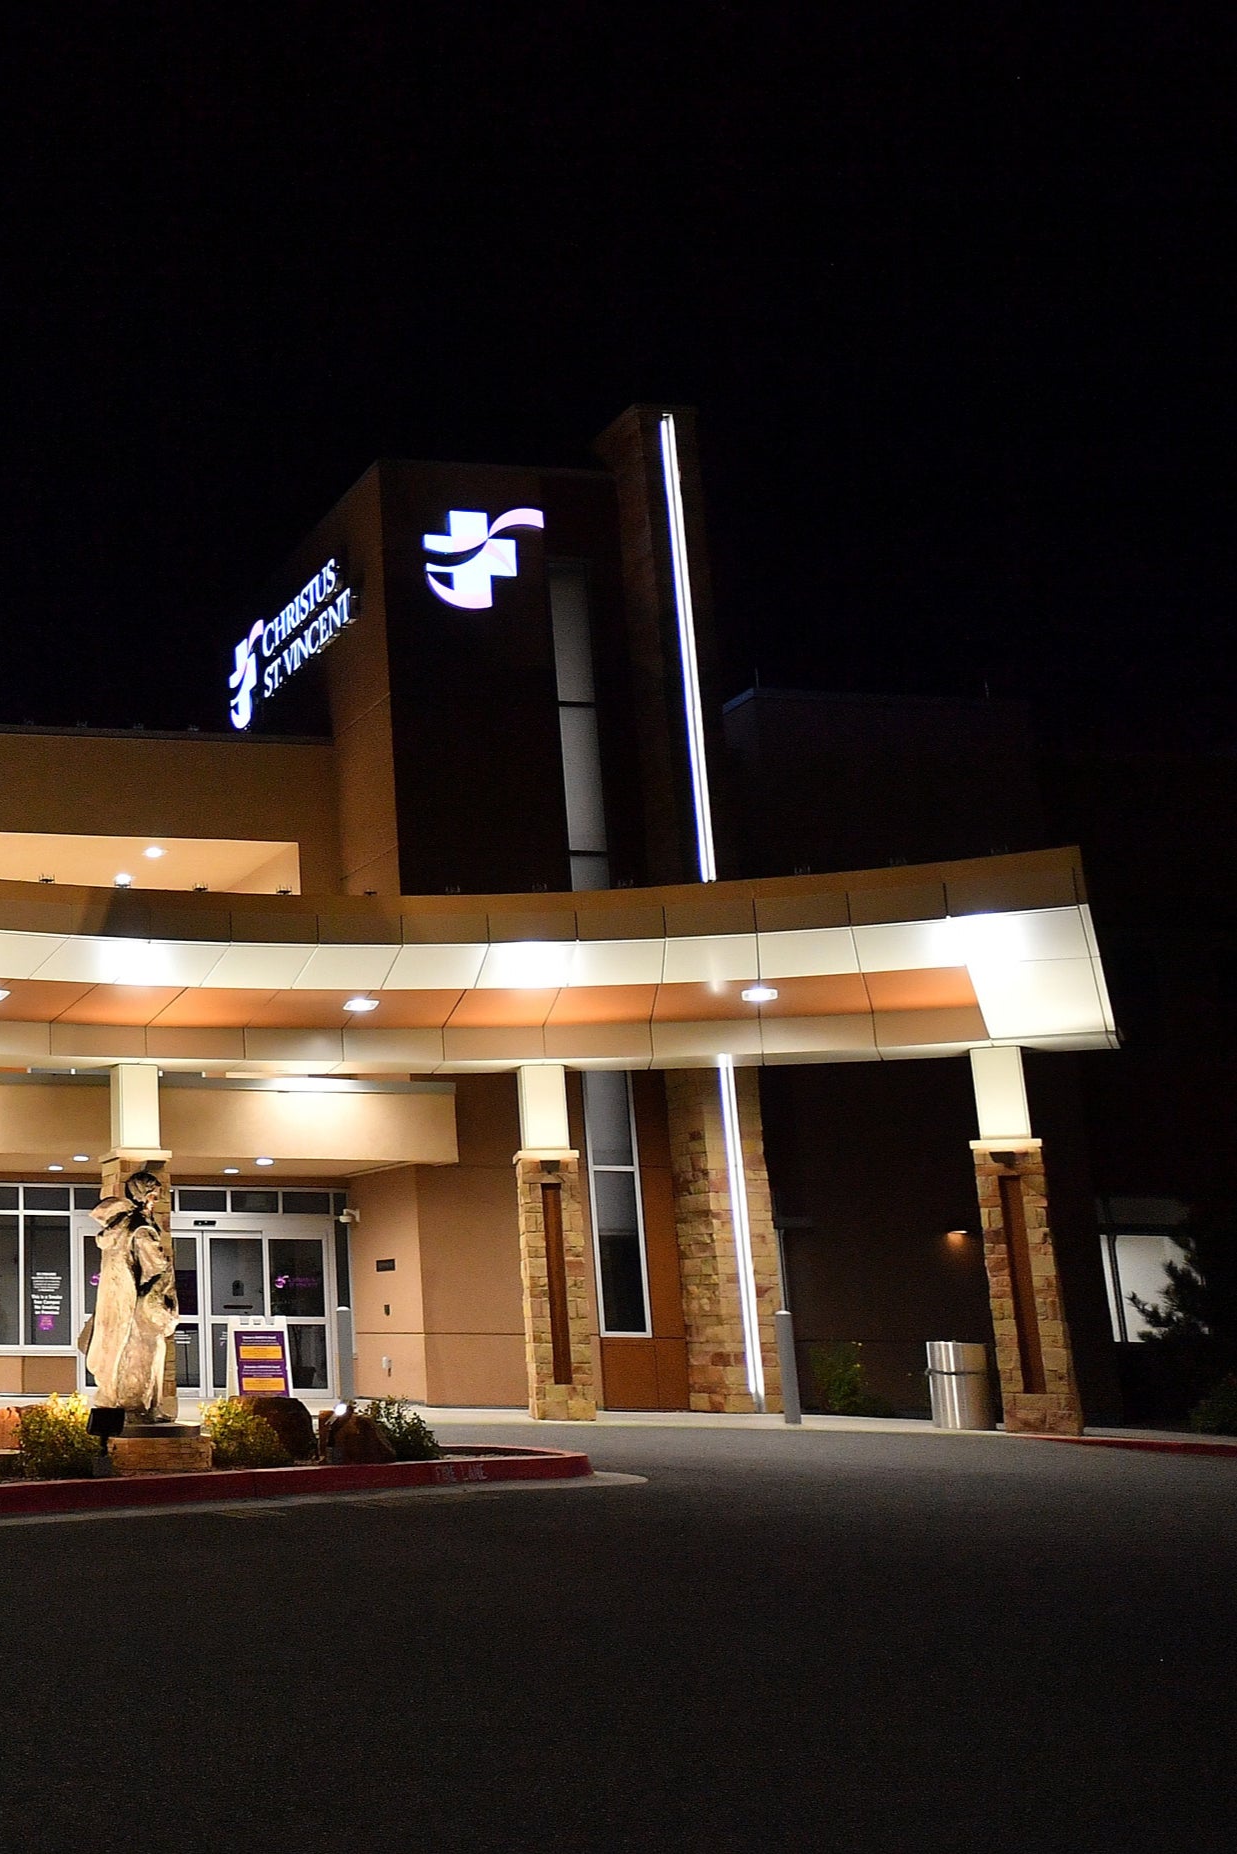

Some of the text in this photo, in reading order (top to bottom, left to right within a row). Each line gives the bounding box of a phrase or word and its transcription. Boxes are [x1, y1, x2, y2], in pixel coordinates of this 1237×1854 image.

[262, 558, 336, 657] CHRISTUS
[264, 587, 350, 698] ST. VINCENT
